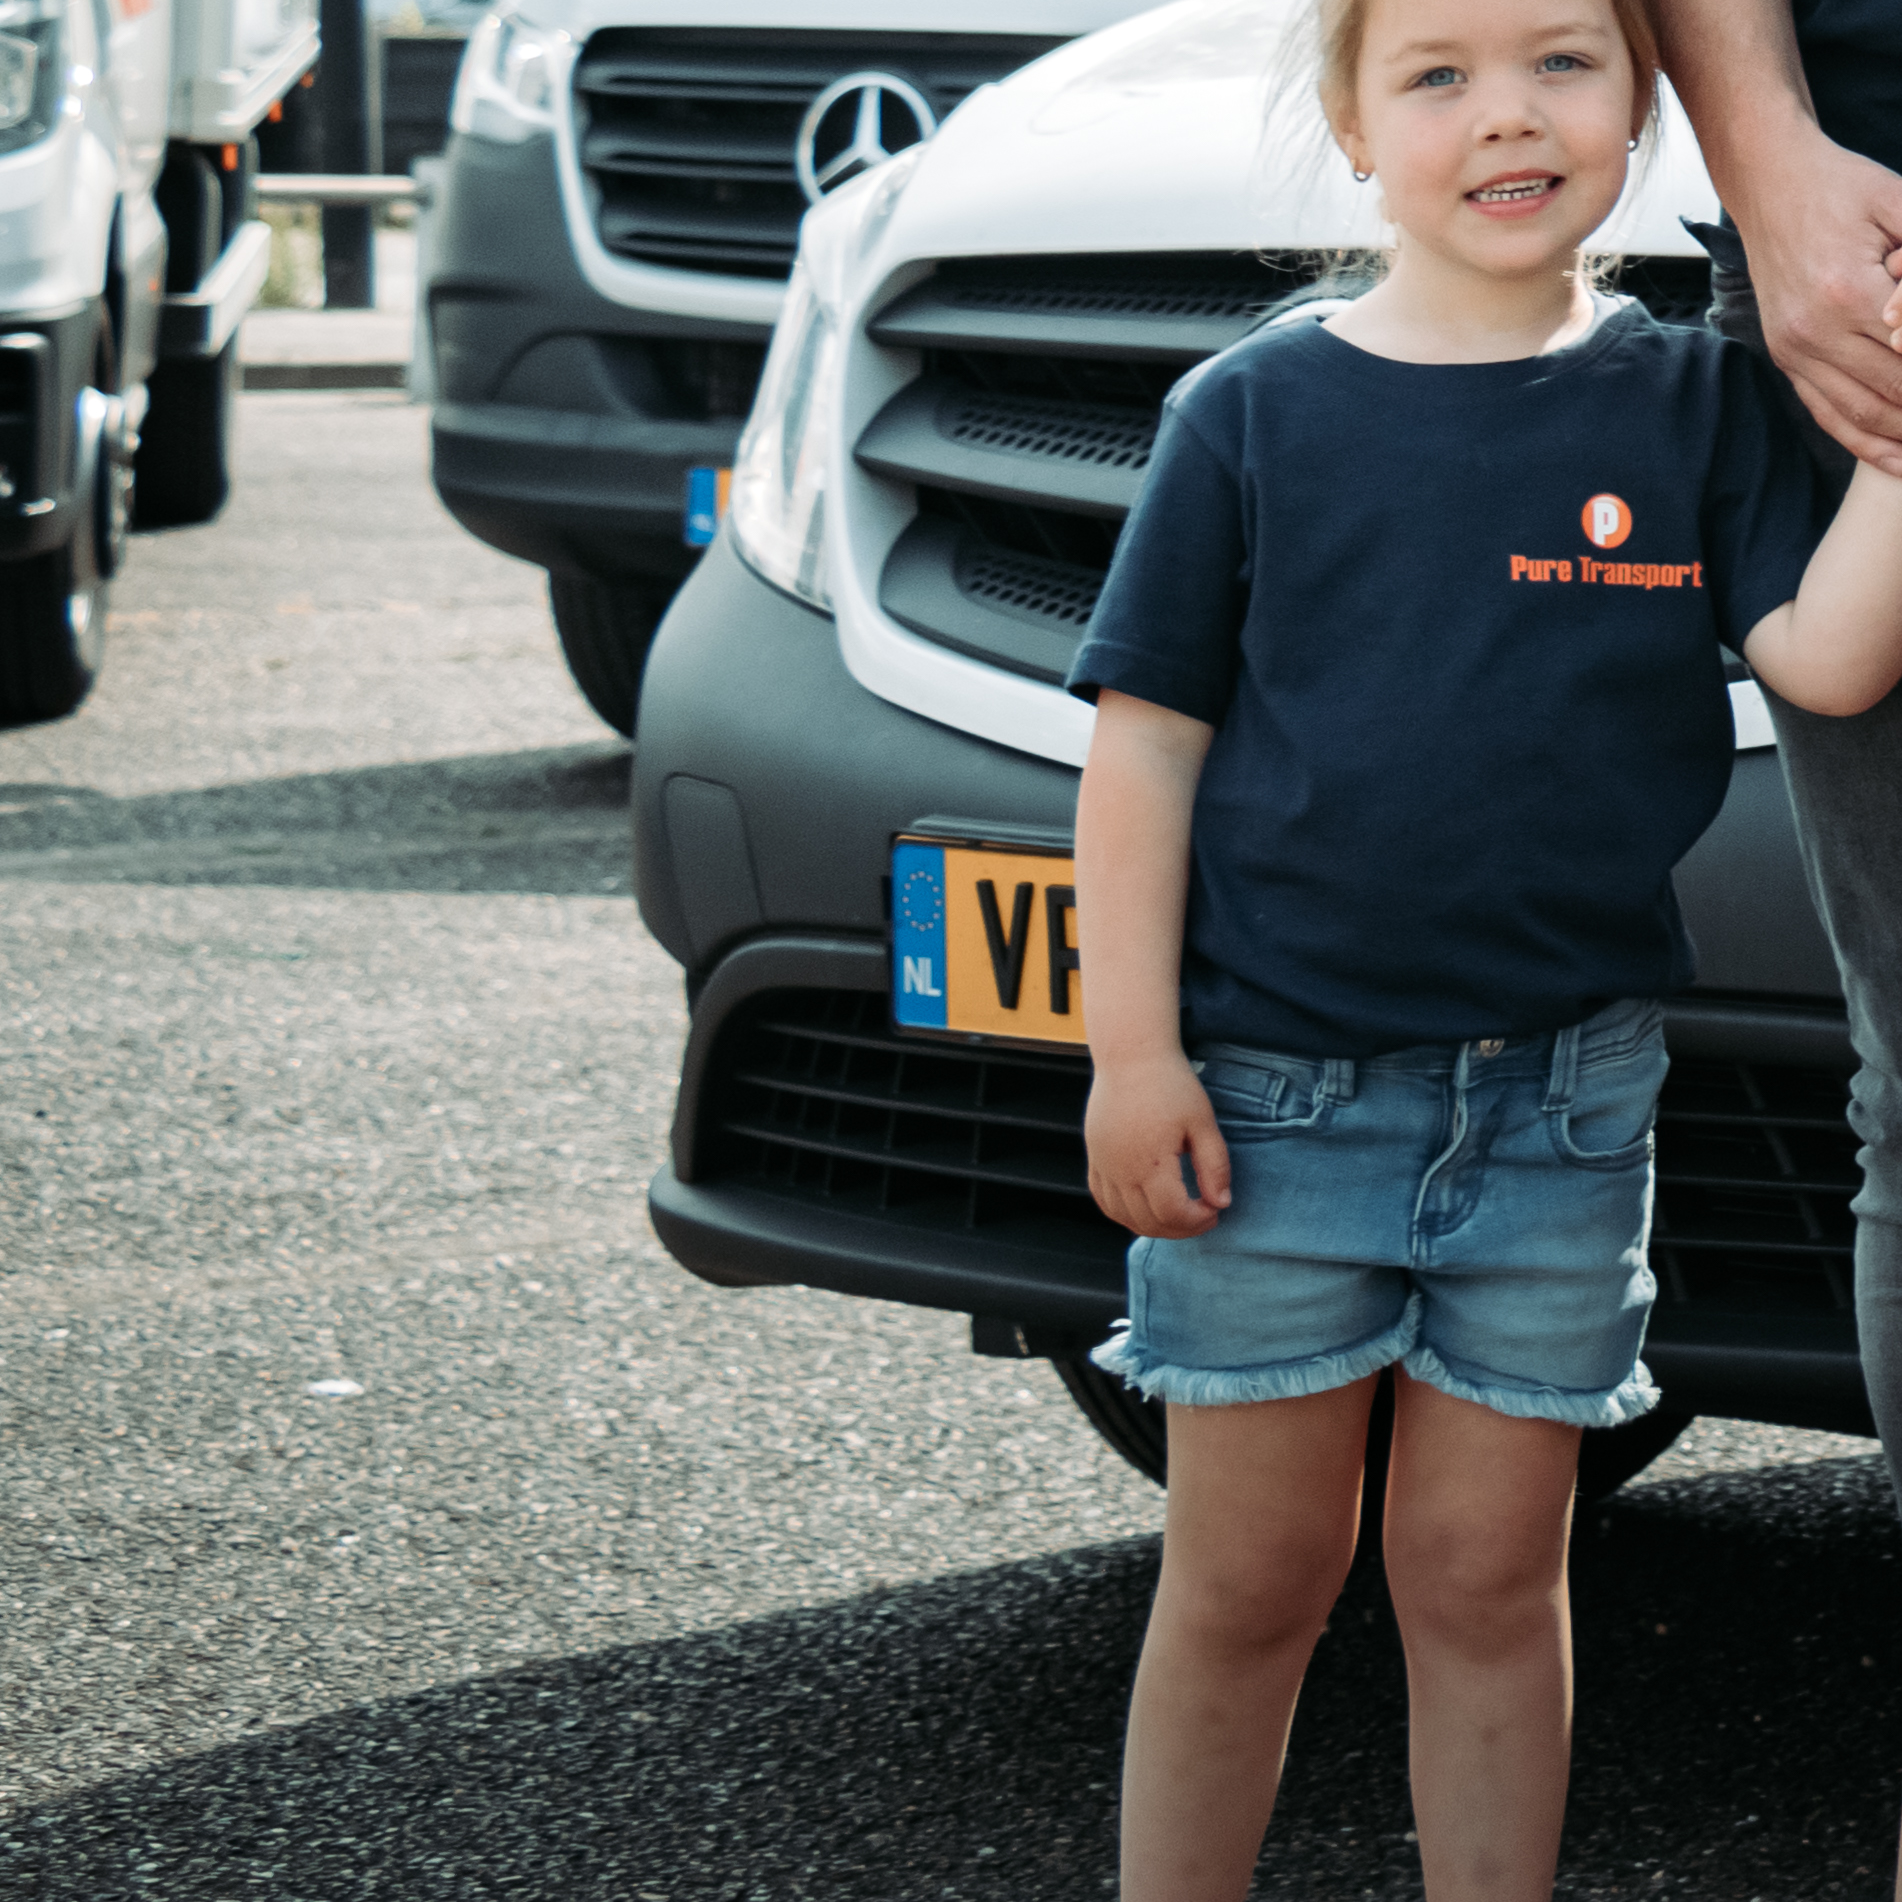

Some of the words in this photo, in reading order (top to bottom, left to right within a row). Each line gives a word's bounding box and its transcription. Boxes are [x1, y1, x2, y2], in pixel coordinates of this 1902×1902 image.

[1509, 554, 1572, 583] Pure
[1578, 555, 1703, 591] Transport
[903, 955, 942, 998] NL
